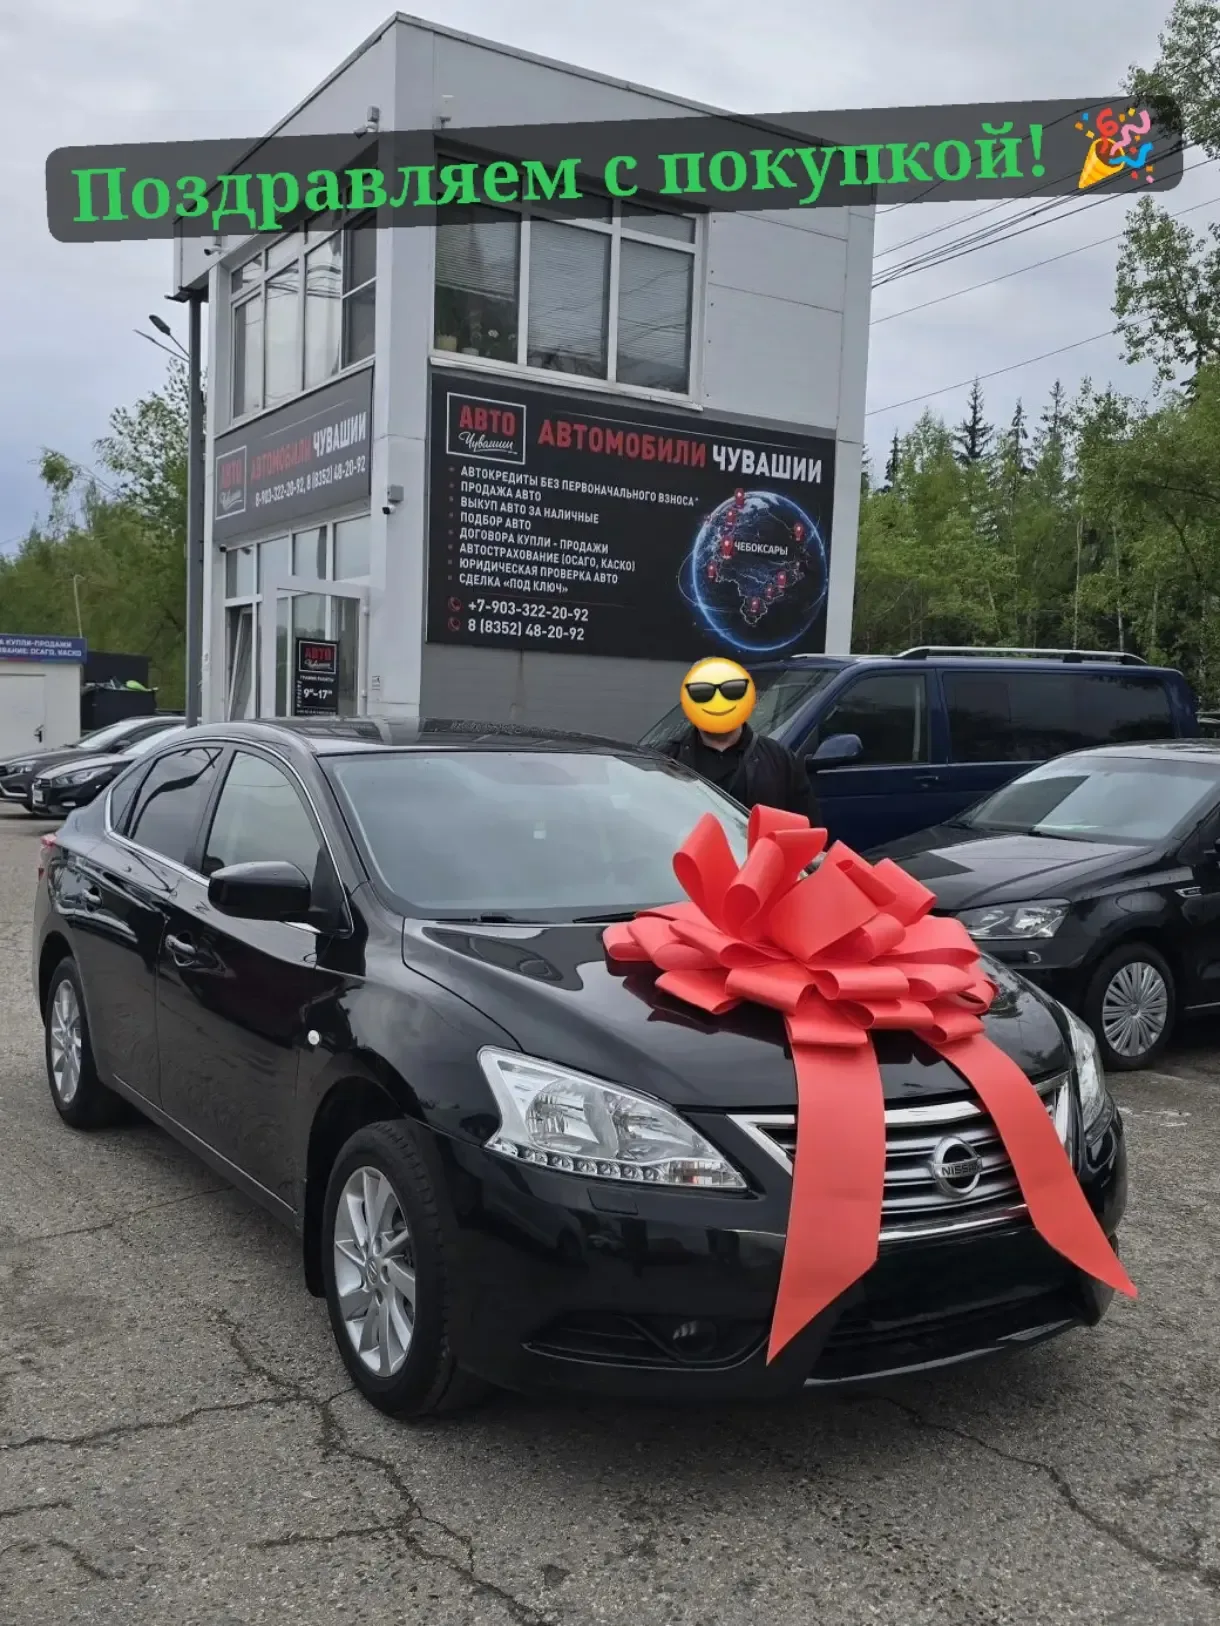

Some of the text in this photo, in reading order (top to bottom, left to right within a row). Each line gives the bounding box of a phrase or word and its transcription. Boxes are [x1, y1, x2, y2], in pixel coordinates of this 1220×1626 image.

[312, 411, 367, 457] ЧУВАШИИ
[459, 404, 516, 437] АВТО
[538, 419, 823, 484] АВТОМОБИЛИ ЧУВАШИИ
[460, 465, 538, 486] АВТОКРЕДИТЫ
[540, 476, 560, 489] БЕЗ
[561, 479, 657, 502] ПЕРВОНАЧАЛЬНОГО
[461, 480, 542, 502] ПРОДАЖА АВТО
[460, 496, 599, 524] ВЫКУП АВТО ЗА НАЛИЧНЫЕ
[460, 511, 531, 531] ПОДБОР АВТО
[459, 527, 515, 543] ДОГОВОРА
[517, 534, 551, 548] КУПЛИ
[560, 539, 609, 554] ПРОДАЖИ
[734, 540, 789, 556] ЧЕБОКСАРЫ
[459, 542, 636, 572] АВТОСТРАХОВАНИЕ (ОСАГО, КАСКО)
[459, 557, 619, 584] ЮРИДИЧЕСКАЯ ПРОВЕРКА АВТО
[459, 573, 568, 594] СДЕЛКА «ПОД КЛЮЧ»
[468, 598, 589, 622] +7-903-322-20-92
[467, 618, 584, 641] 8 (8352) 48-20-92
